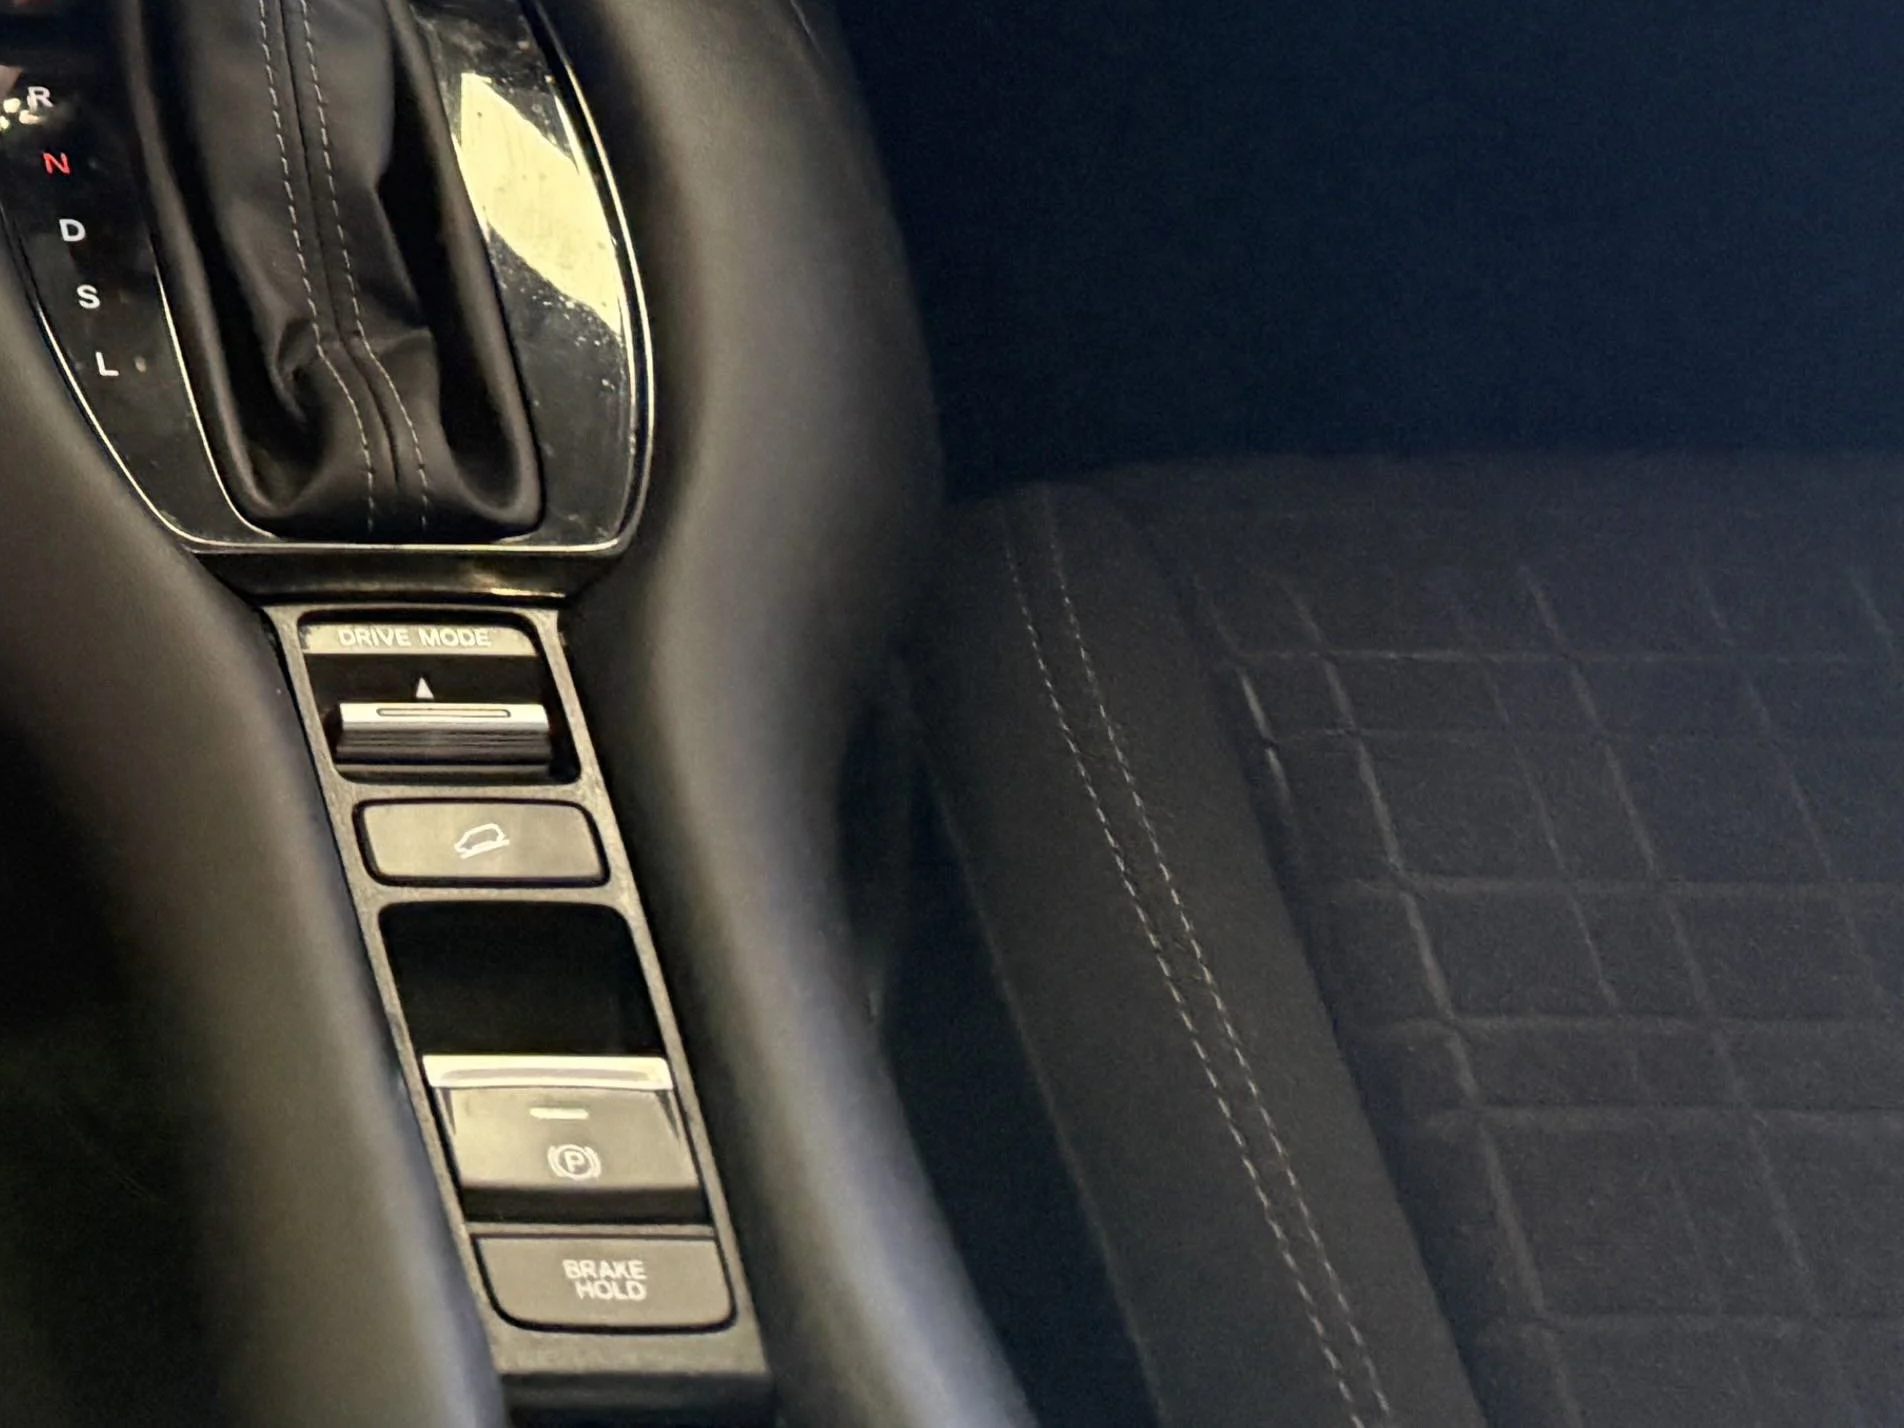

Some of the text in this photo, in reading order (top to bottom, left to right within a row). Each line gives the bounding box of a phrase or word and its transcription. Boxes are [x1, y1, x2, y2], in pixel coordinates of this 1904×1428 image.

[27, 86, 52, 108] R
[44, 153, 70, 174] N
[60, 219, 85, 243] D
[77, 284, 100, 309] S
[97, 352, 119, 377] L
[338, 627, 491, 648] DRIVE MODE
[562, 1259, 648, 1279] BRAKE
[574, 1279, 648, 1301] HOLD
